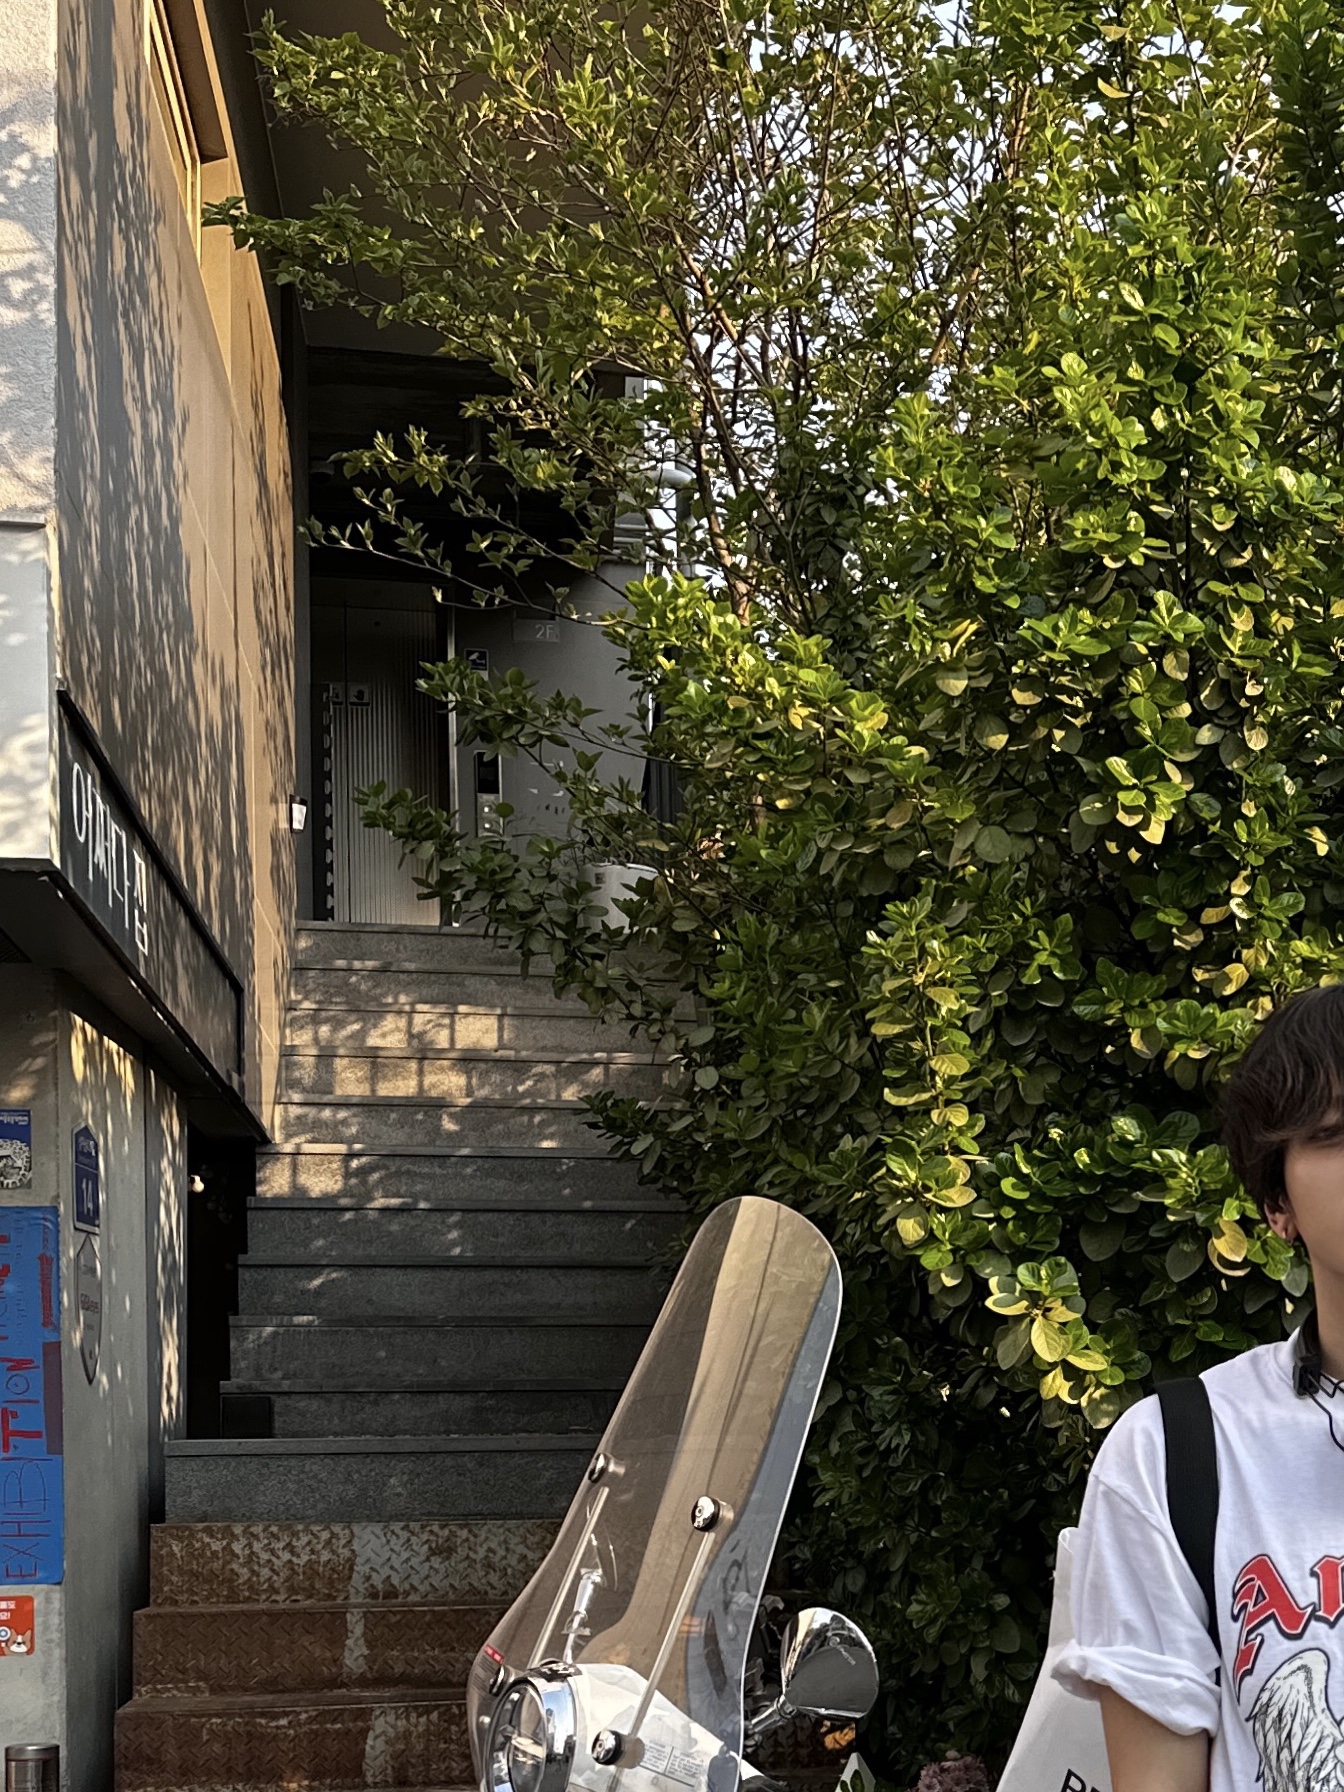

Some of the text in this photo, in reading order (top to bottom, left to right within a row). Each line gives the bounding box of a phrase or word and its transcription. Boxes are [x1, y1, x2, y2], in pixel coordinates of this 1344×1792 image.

[534, 623, 554, 639] 2F
[81, 1177, 94, 1217] 14
[0, 1357, 53, 1579] EXHIBITION
